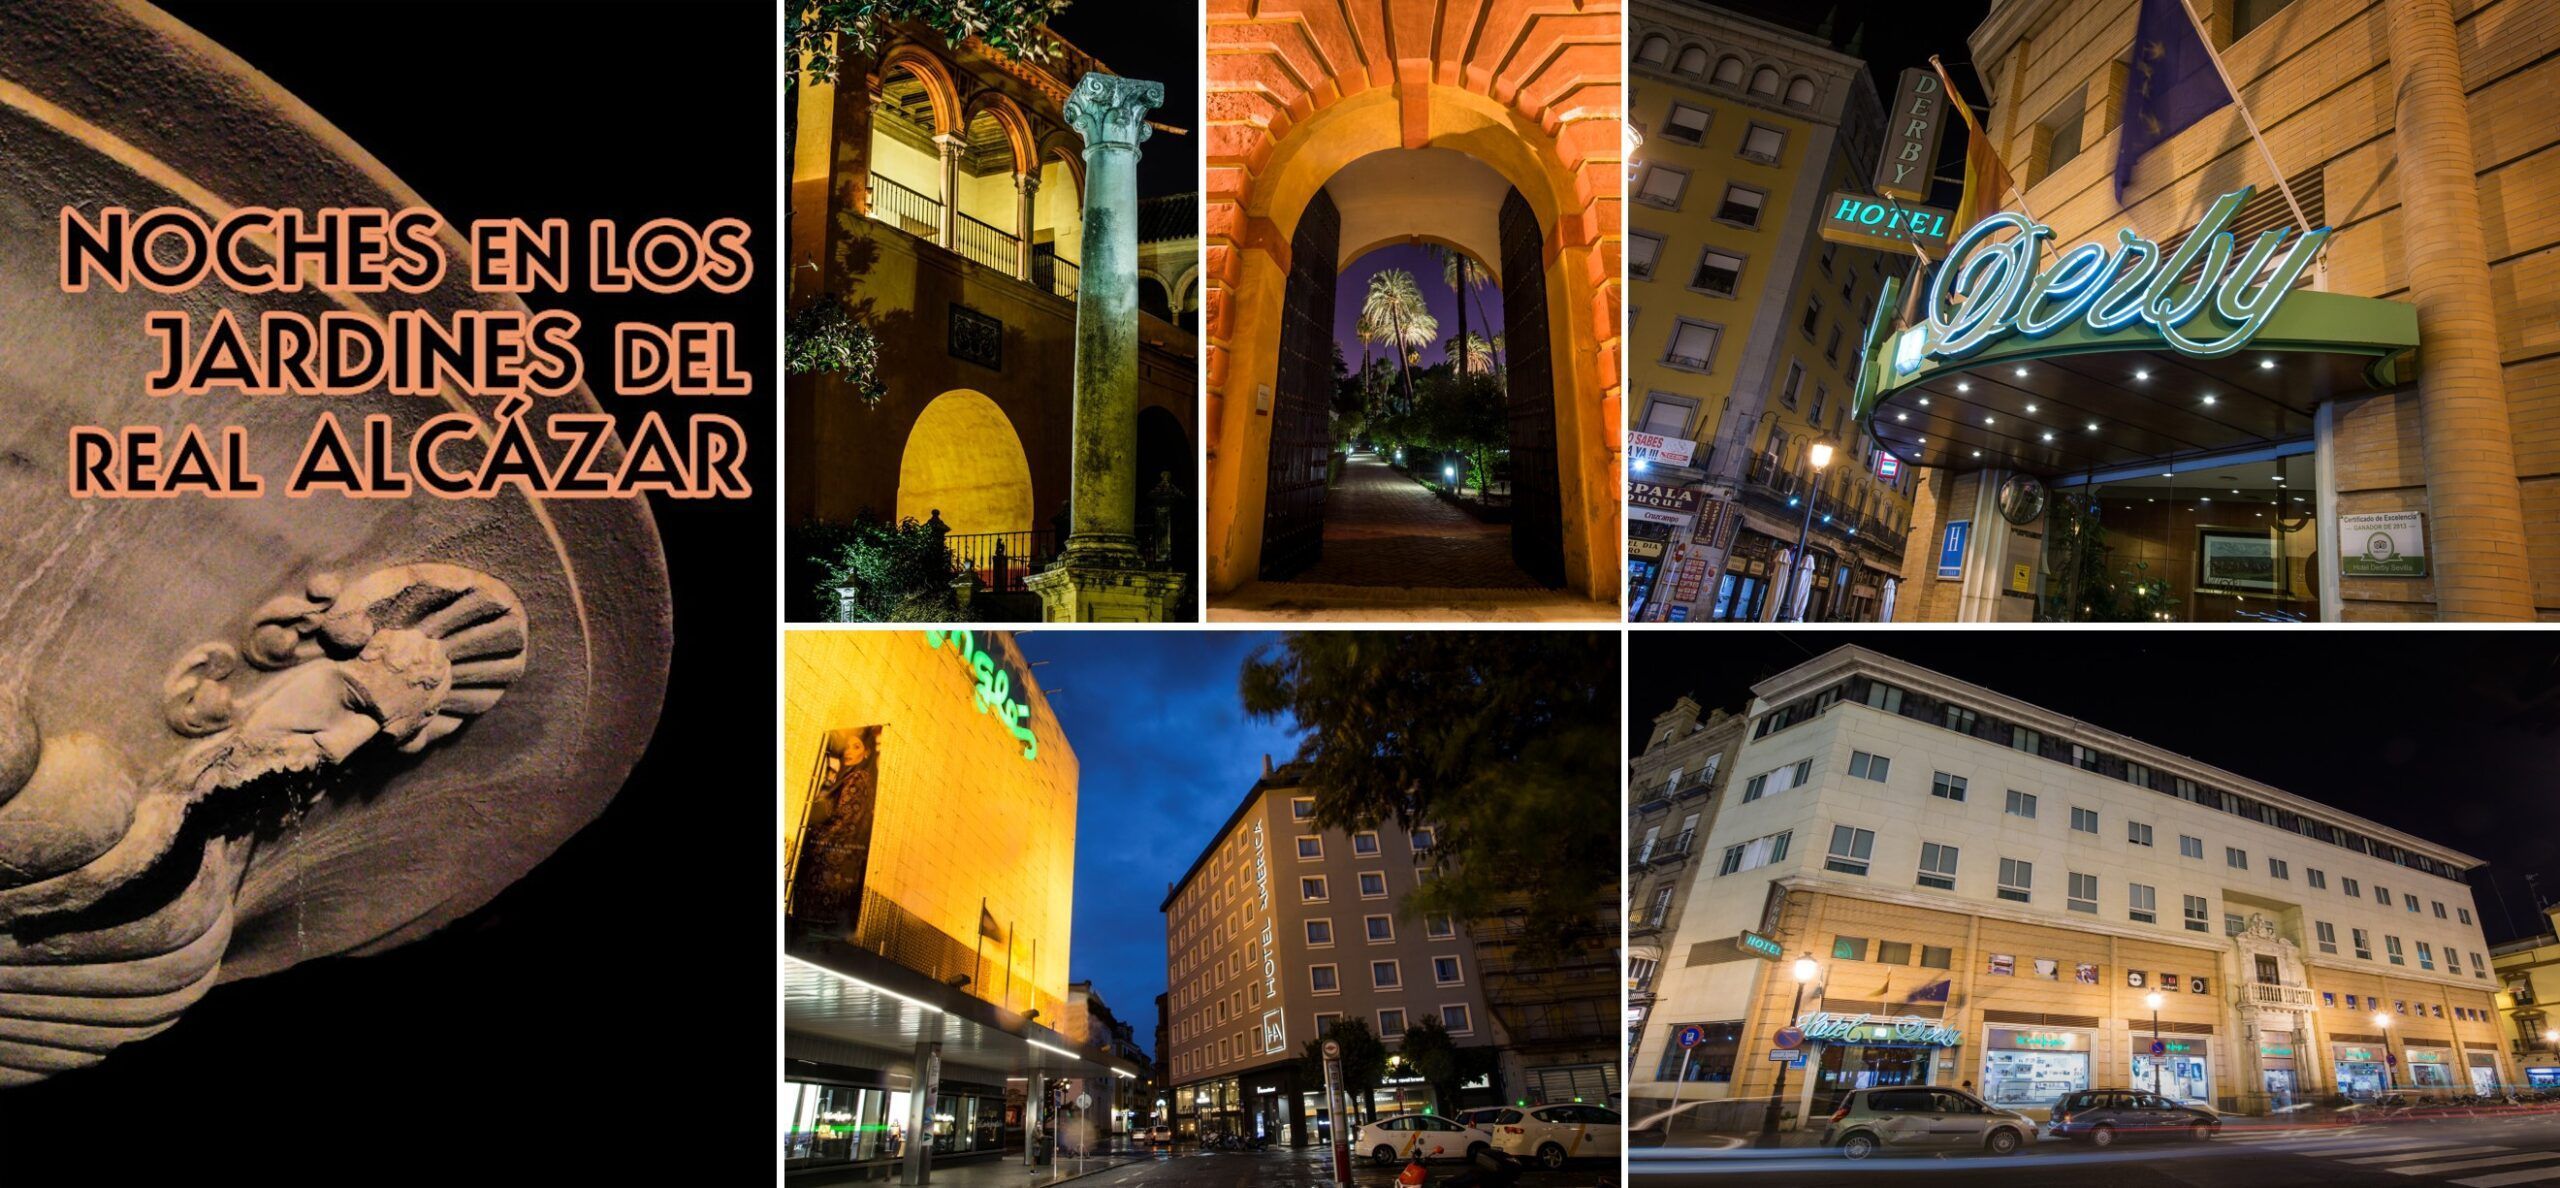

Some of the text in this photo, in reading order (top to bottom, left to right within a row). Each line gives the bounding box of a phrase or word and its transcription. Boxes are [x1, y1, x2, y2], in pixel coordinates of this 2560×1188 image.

[1893, 75, 1938, 183] DERBY
[1835, 200, 1945, 237] HOTEL
[1922, 184, 2332, 359] Derby
[1635, 434, 1663, 448] SABES
[1635, 446, 1647, 458] YA
[2343, 515, 2374, 523] Certificado
[2383, 513, 2417, 522] Excelencia
[1642, 542, 1658, 550] DIA
[1947, 526, 1962, 551] H
[1261, 917, 1276, 998] HOTEL
[1746, 934, 1782, 956] HOTEL
[1796, 1012, 1962, 1047] Hotel Derby
